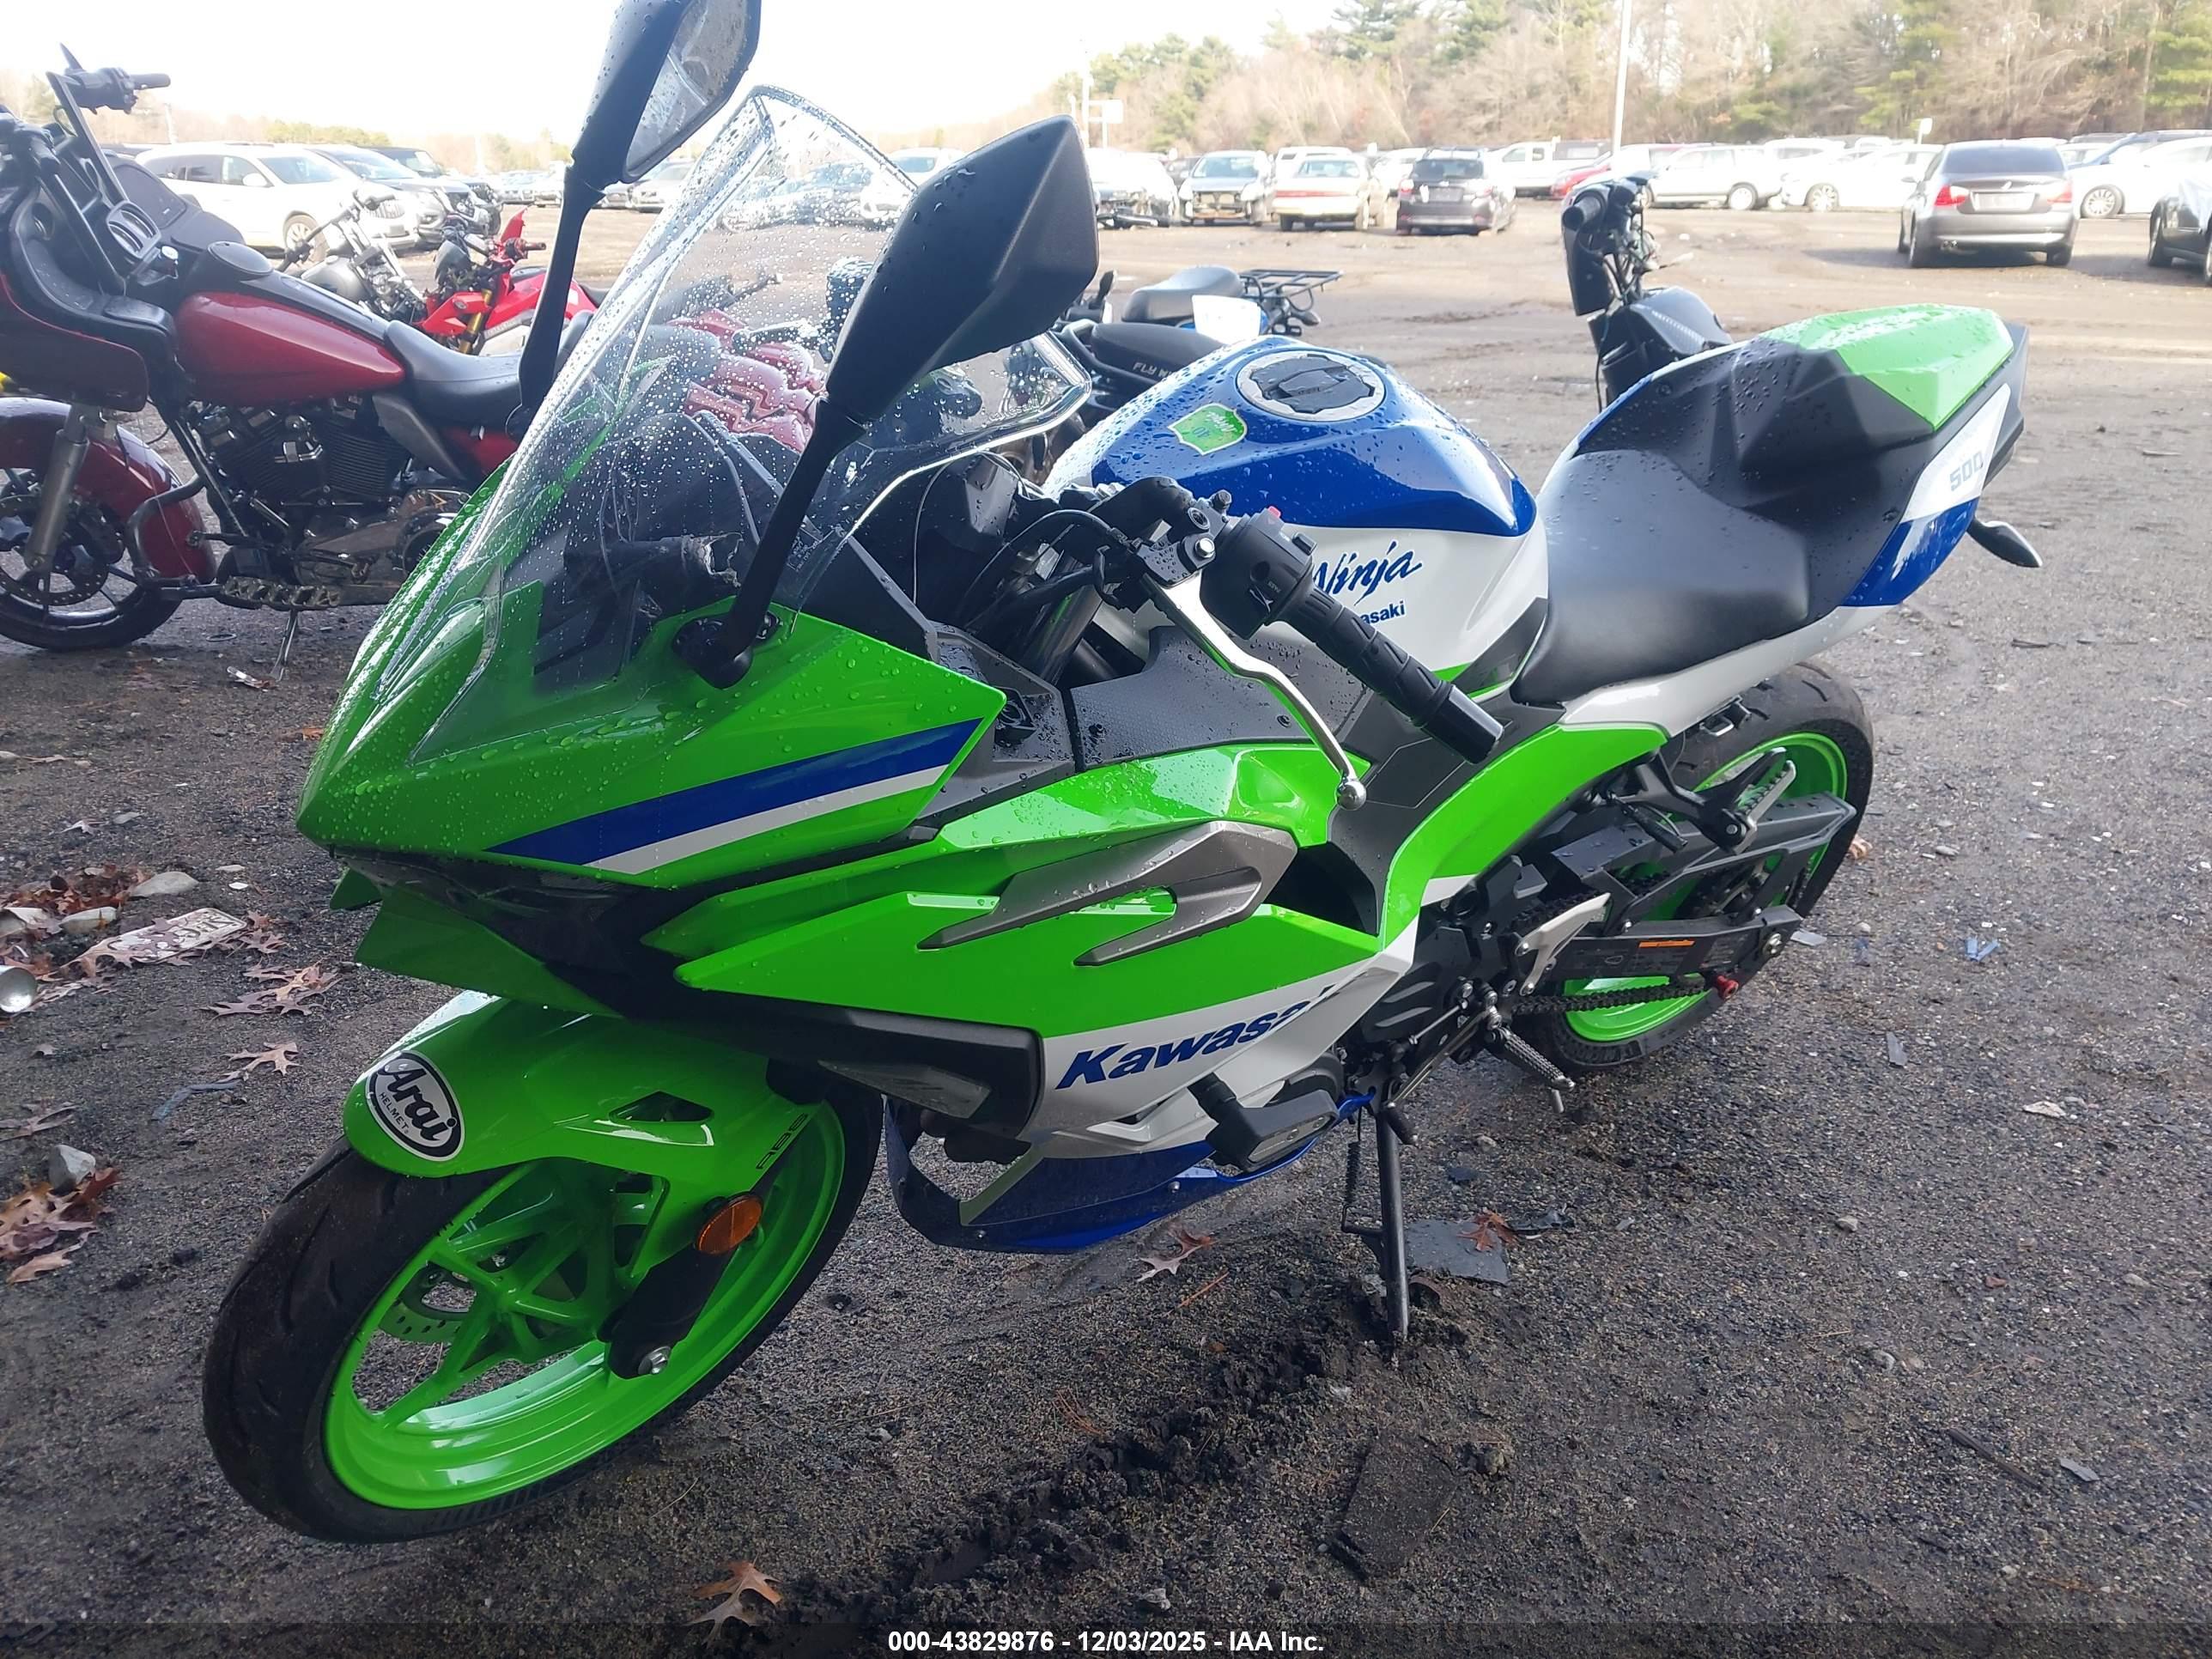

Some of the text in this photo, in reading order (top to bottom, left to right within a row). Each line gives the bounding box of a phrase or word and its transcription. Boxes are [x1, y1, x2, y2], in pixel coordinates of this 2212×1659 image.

[1949, 451, 1984, 492] 500
[1312, 541, 1422, 606] Ninja
[1359, 599, 1406, 625] asaki
[377, 1067, 458, 1141] Arai
[379, 1091, 410, 1131] HELMET
[755, 1112, 809, 1170] ABS
